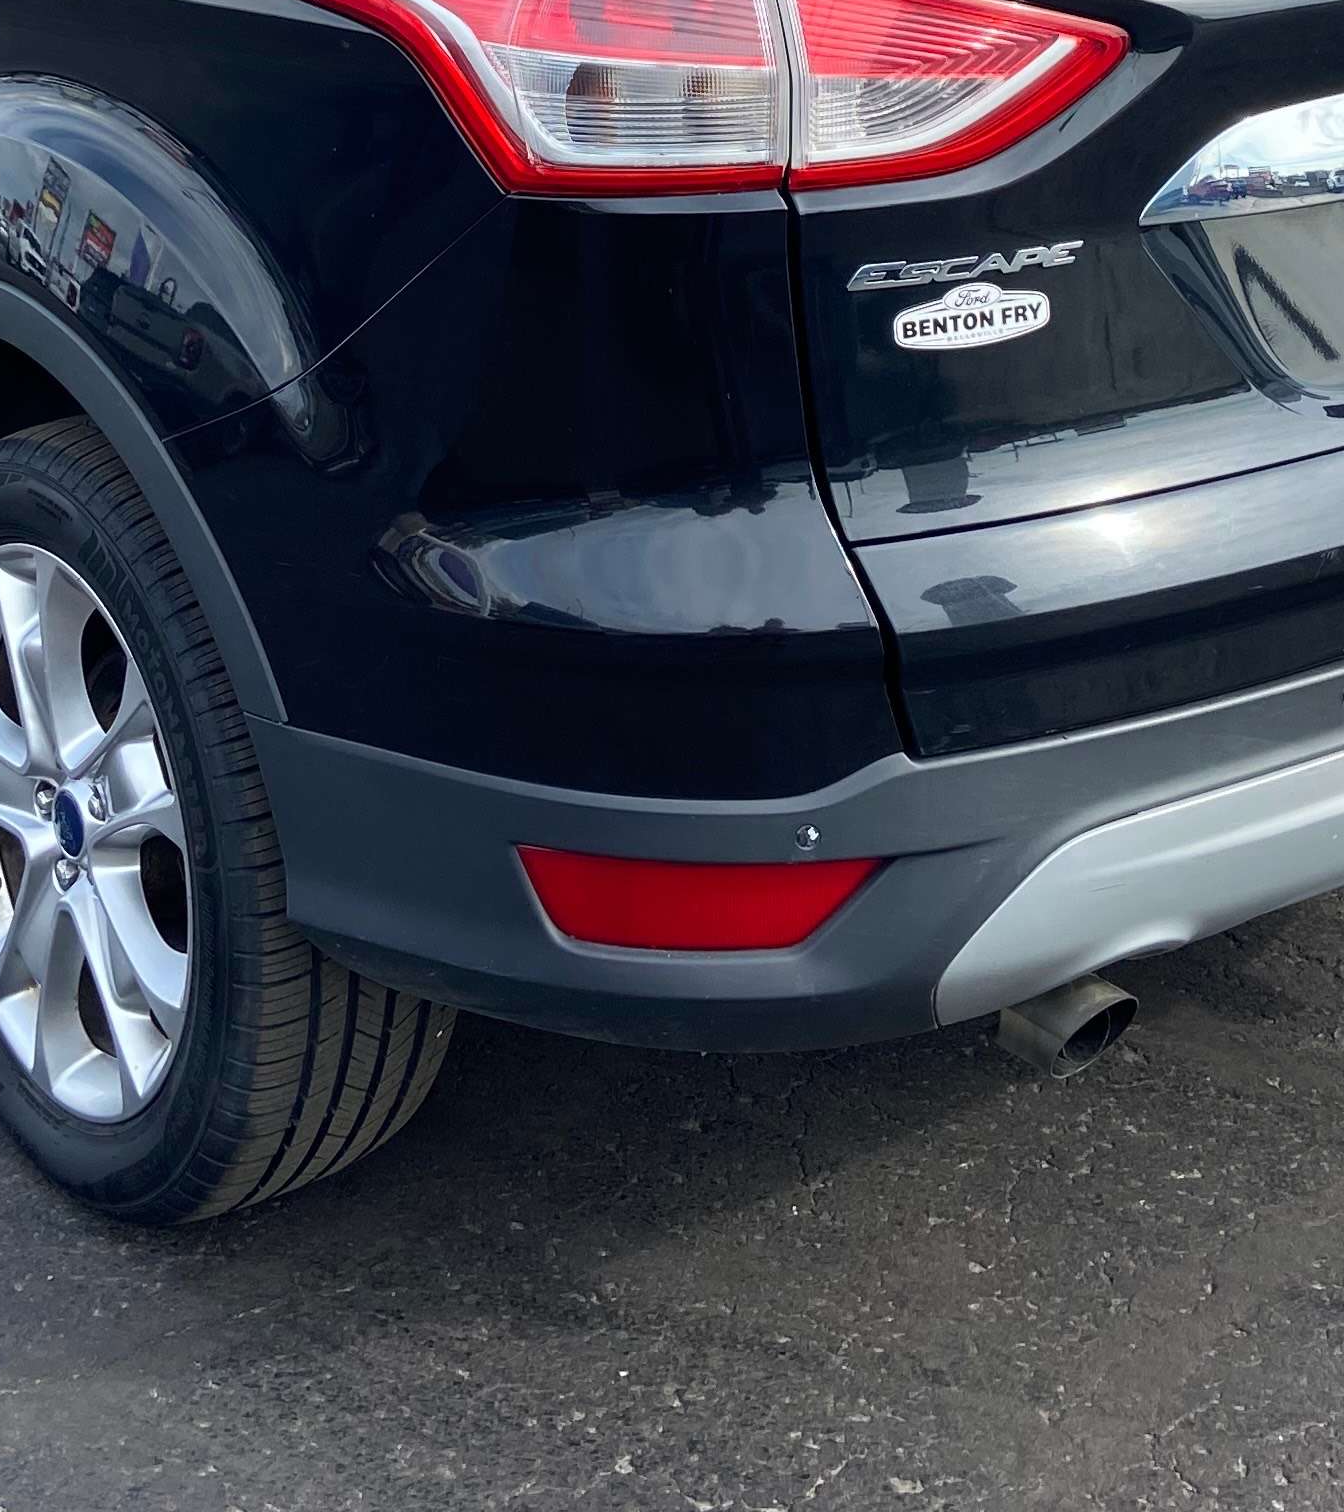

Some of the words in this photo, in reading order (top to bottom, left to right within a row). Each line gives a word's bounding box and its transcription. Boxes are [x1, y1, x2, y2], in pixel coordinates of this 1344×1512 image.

[847, 240, 1084, 291] ESCAPE
[955, 288, 990, 308] Ford
[902, 308, 995, 339] BENTON
[1001, 301, 1043, 326] FRY
